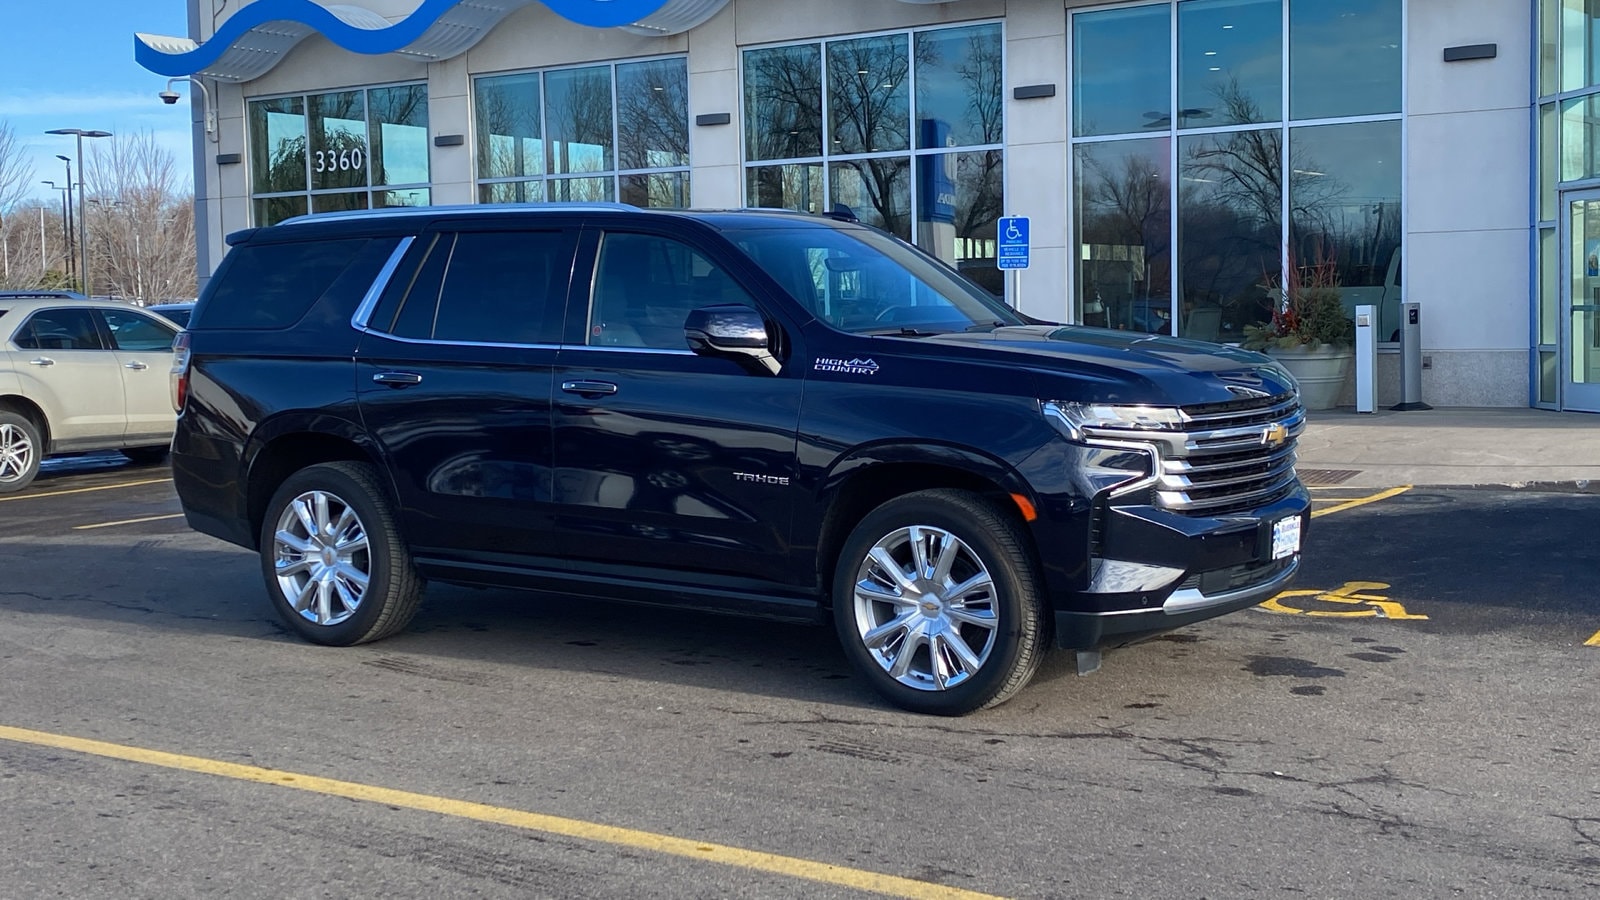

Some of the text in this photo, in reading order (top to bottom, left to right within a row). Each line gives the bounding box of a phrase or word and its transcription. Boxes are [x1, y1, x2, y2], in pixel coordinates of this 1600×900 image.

[316, 148, 361, 172] 3360
[815, 357, 848, 367] HIGH
[814, 364, 878, 375] COUNTRY
[733, 472, 789, 485] TAHOE
